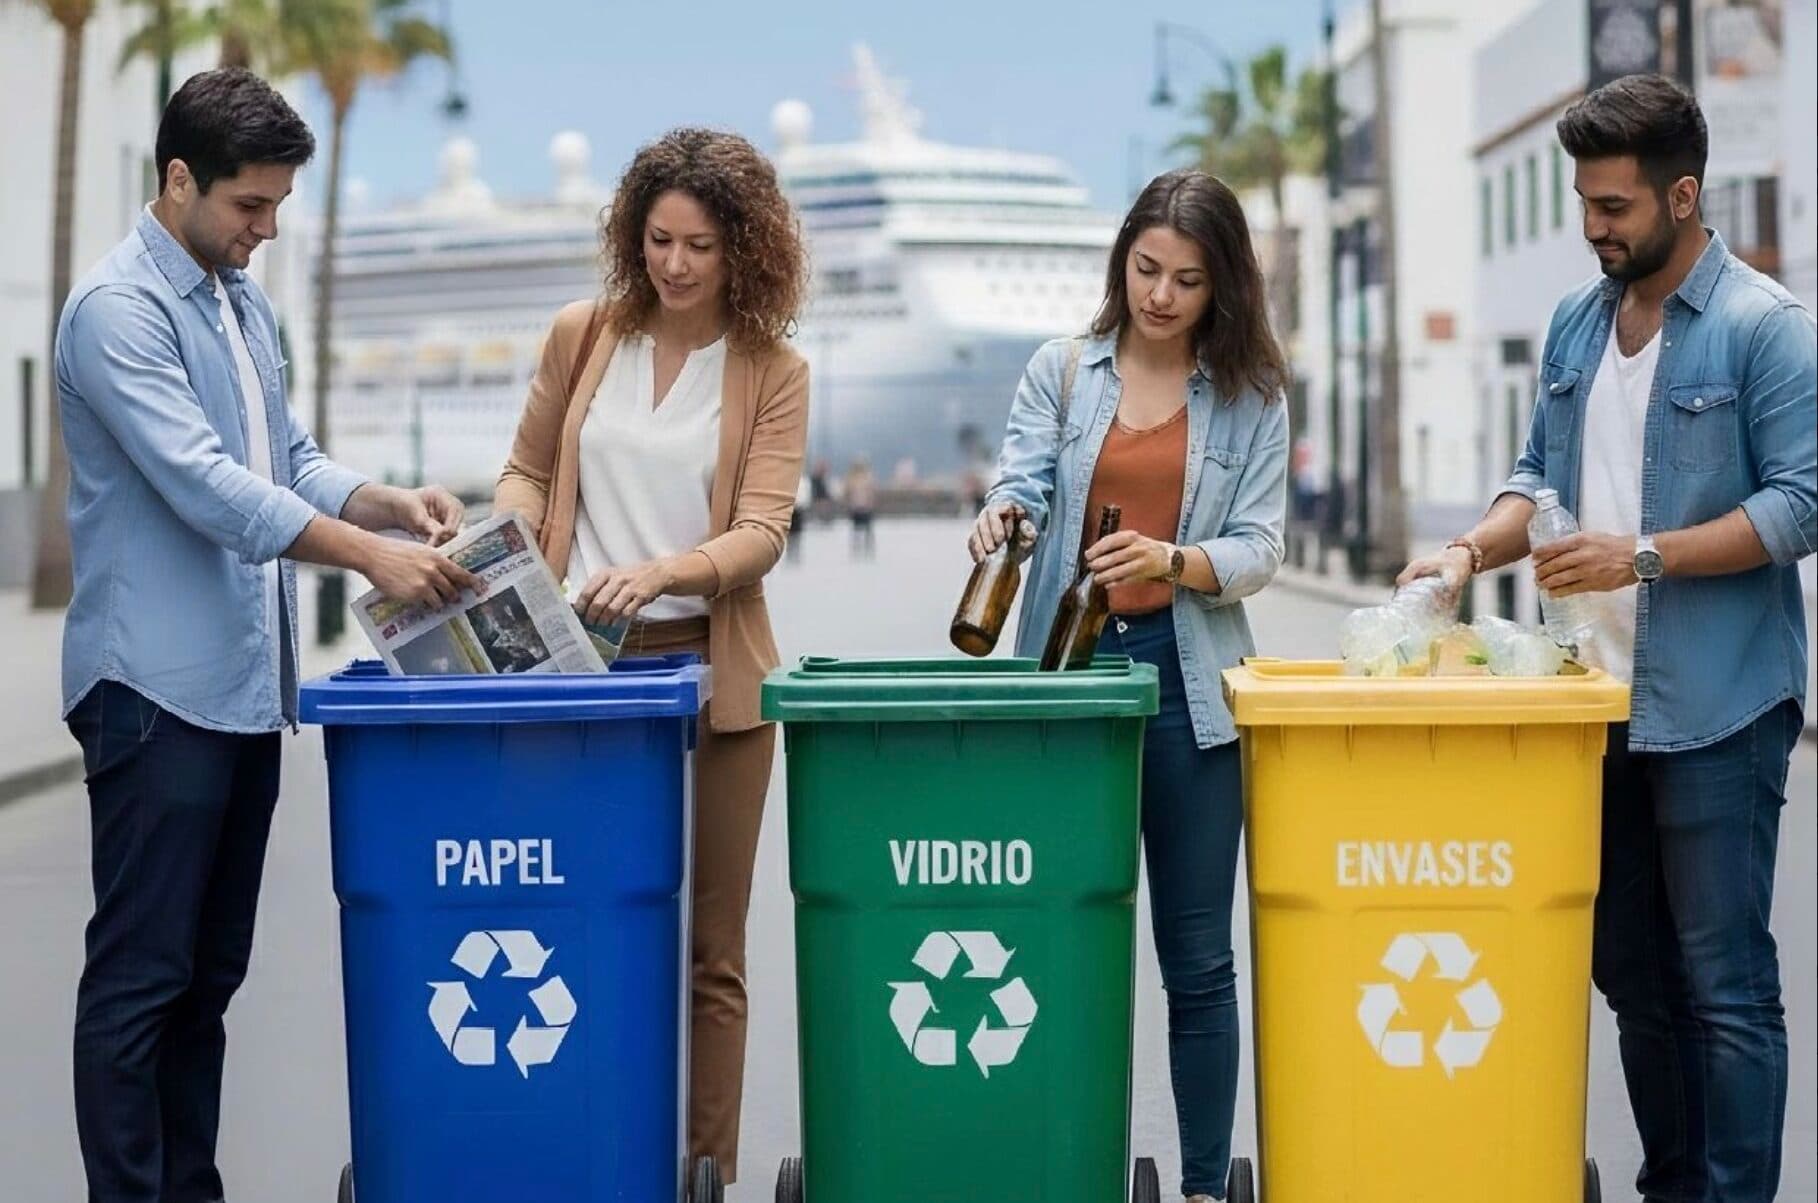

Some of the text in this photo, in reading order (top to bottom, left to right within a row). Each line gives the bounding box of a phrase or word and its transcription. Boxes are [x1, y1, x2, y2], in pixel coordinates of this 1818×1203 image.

[436, 839, 565, 887] PAPEL
[889, 839, 1033, 886] VIDRIO
[1337, 841, 1514, 887] ENVASES
